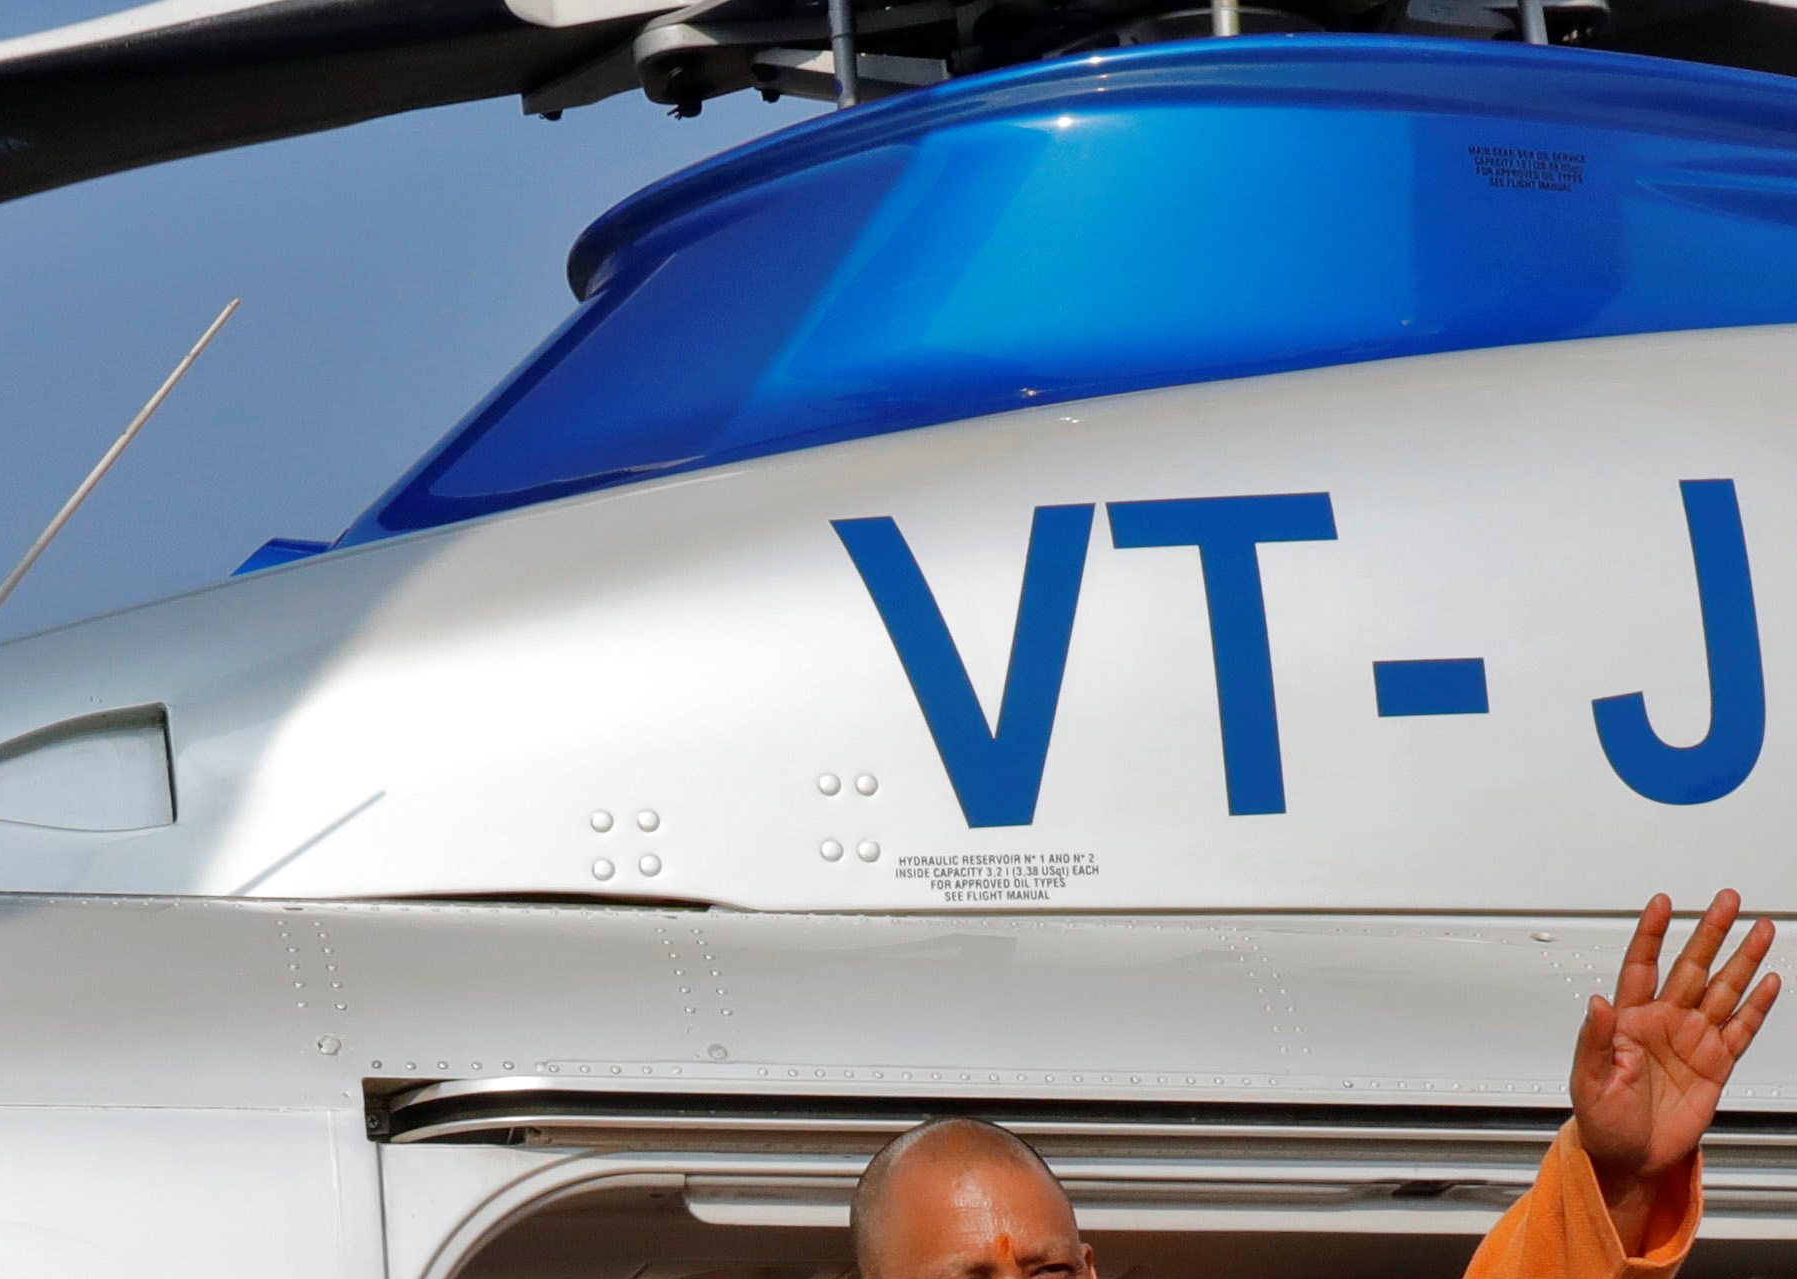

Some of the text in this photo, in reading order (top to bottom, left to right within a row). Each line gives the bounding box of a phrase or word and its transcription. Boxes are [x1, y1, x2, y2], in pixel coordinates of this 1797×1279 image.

[899, 855, 959, 867] HYDRAULIC
[962, 854, 1021, 866] RESERVOIR
[1048, 853, 1070, 864] AND
[895, 868, 930, 879] INSIDE
[933, 867, 983, 878] CAPACITY
[1072, 865, 1099, 876] EACH
[930, 876, 1066, 890] FOR APPROVED OIL TYPES
[944, 890, 1051, 902] SEE FLIGHT MANUAL
